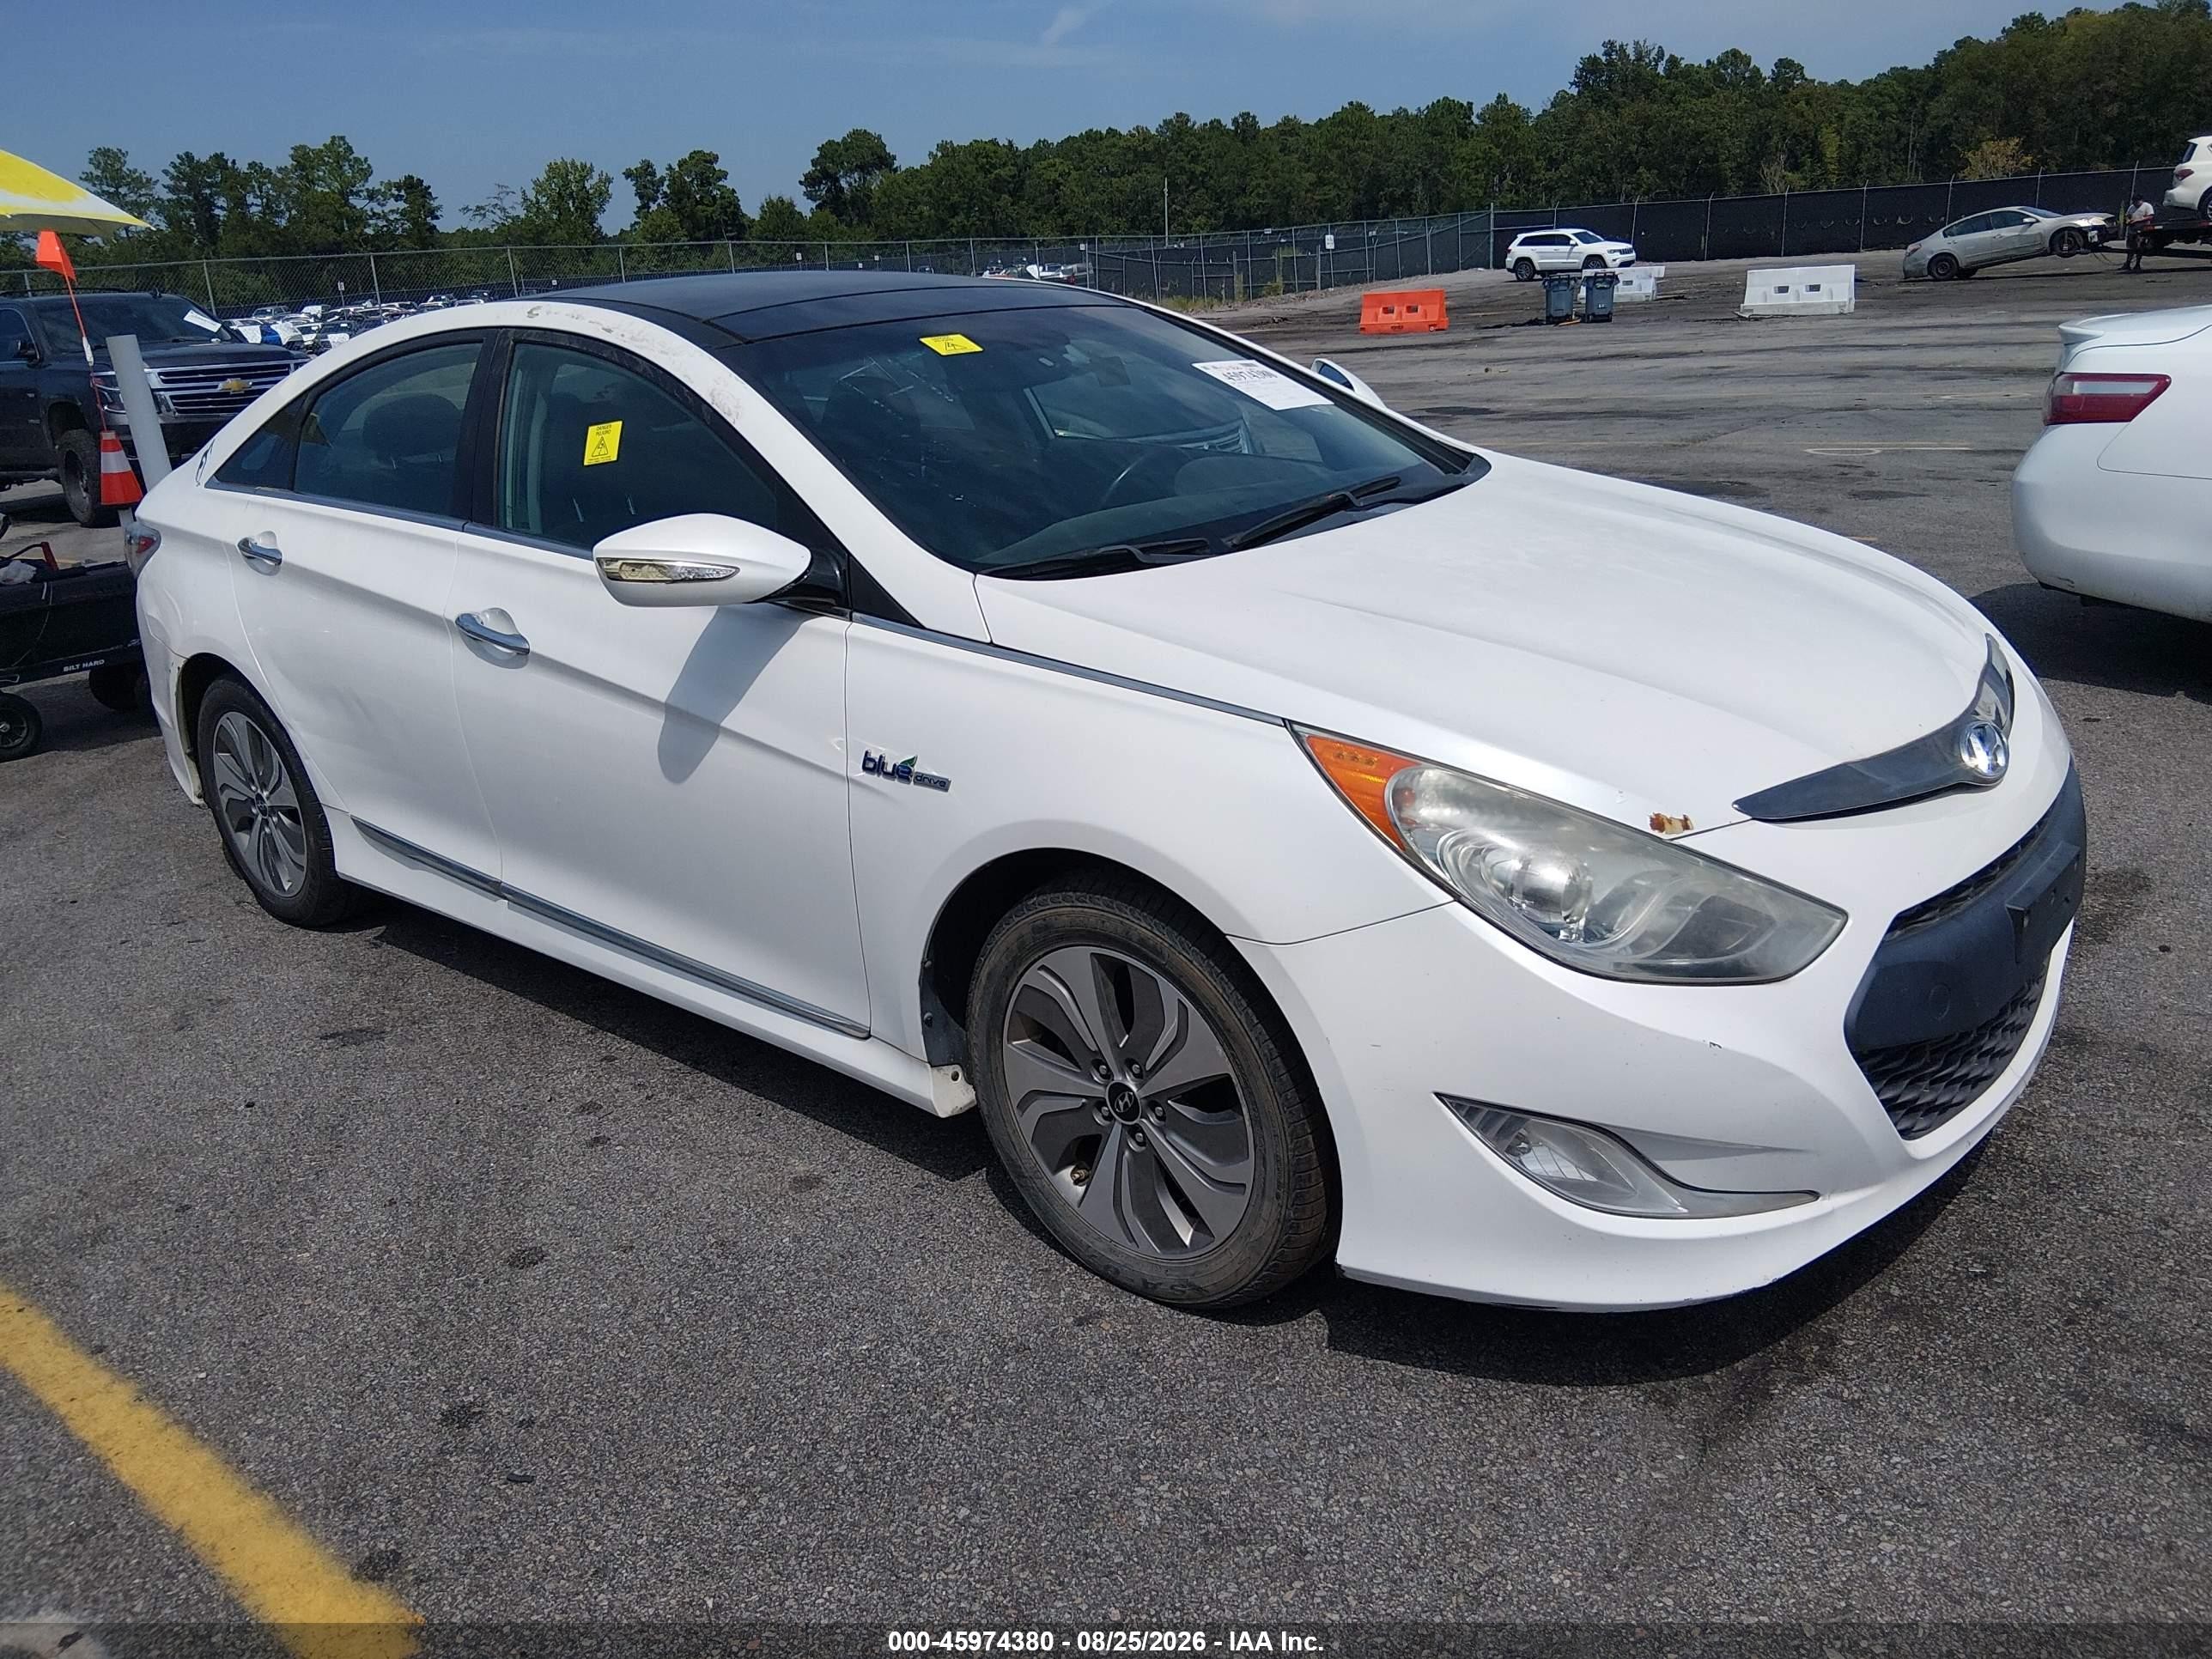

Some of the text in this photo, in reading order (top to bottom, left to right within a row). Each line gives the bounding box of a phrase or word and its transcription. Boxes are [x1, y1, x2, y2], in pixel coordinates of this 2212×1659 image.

[63, 659, 105, 672] BILT HARD
[862, 749, 914, 785] blue
